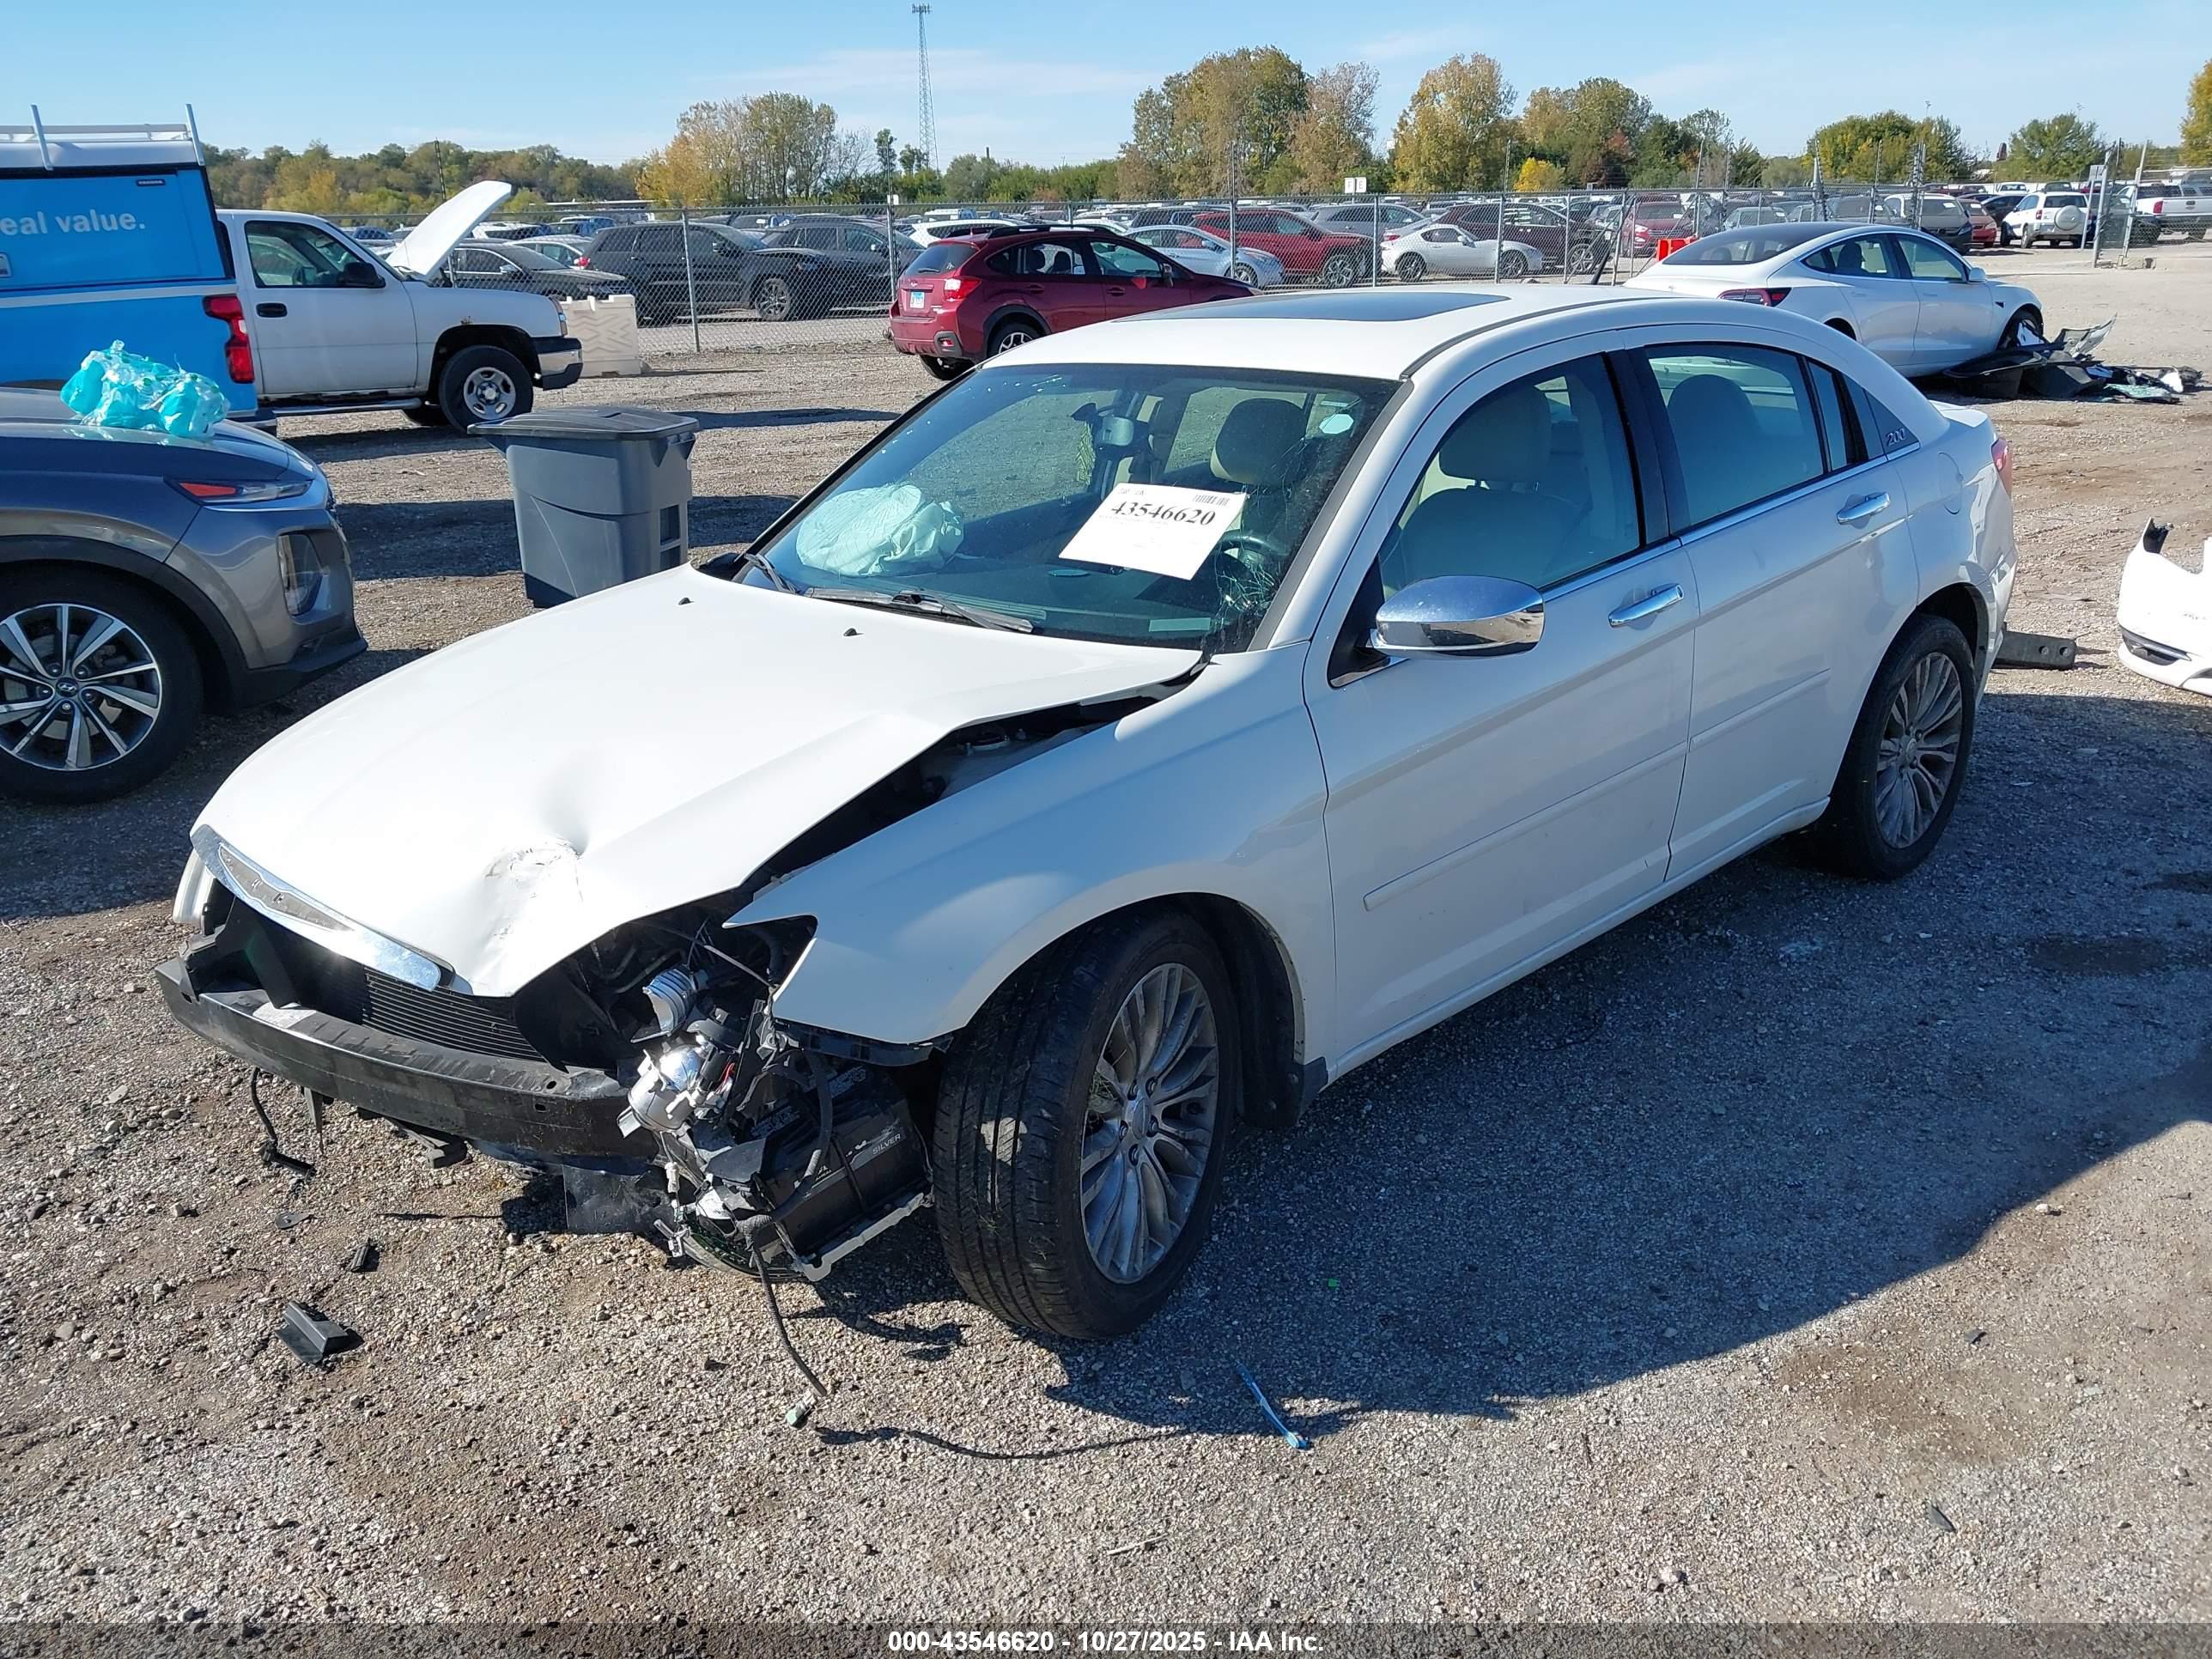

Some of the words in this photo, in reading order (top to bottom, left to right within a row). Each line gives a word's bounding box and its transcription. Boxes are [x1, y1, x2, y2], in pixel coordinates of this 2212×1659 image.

[55, 209, 145, 233] value.
[1111, 500, 1217, 526] 43546620
[872, 1133, 902, 1156] SILVER
